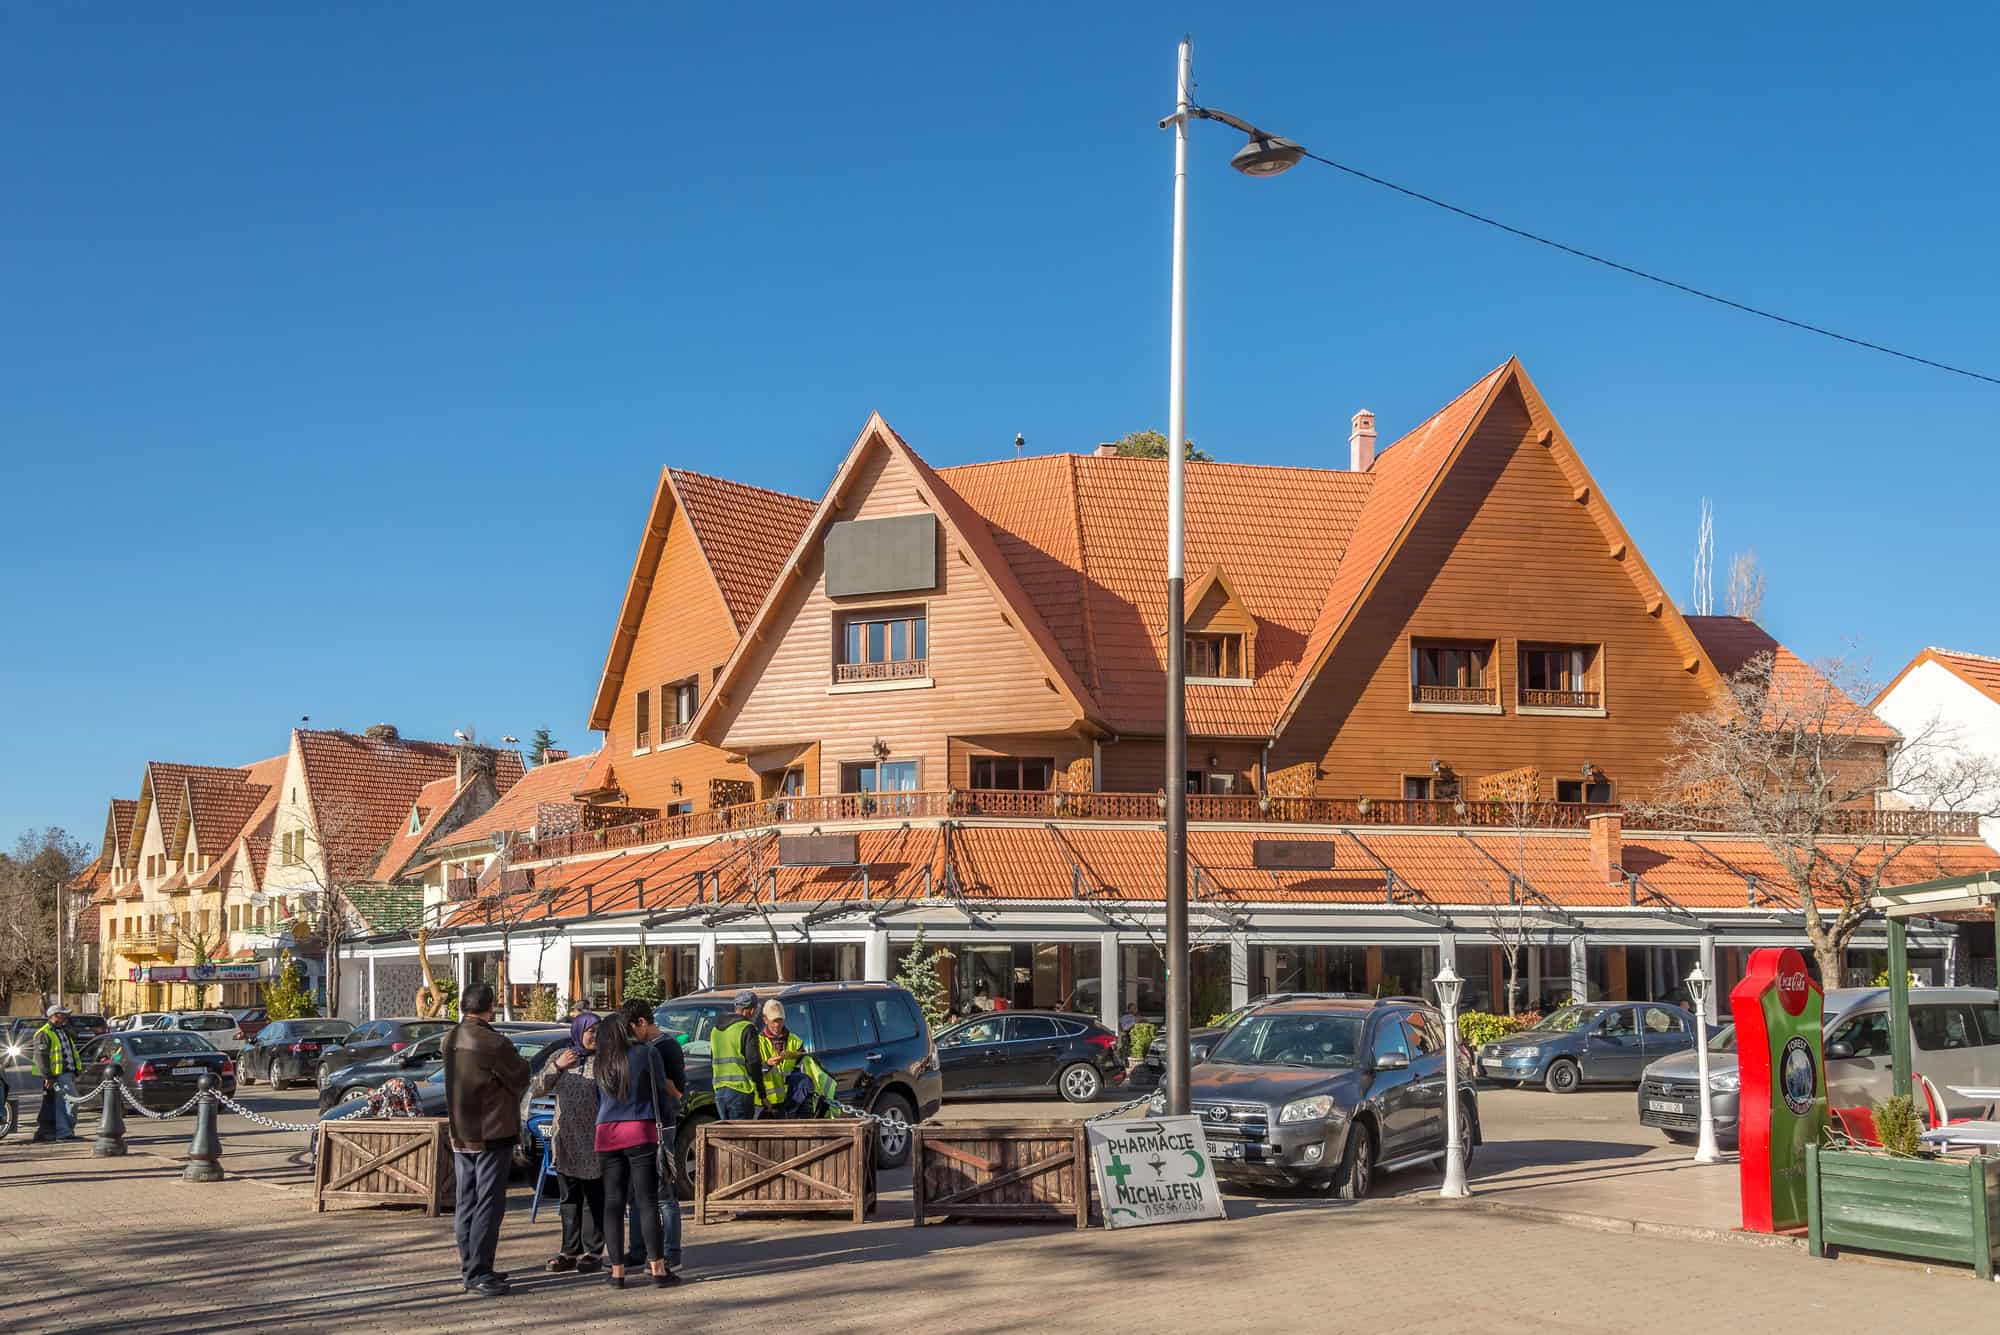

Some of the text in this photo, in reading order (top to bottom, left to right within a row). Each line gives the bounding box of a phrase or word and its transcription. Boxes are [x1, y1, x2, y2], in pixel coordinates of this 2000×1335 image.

[1787, 1039, 1808, 1053] FOREST
[1107, 1133, 1195, 1154] PHARMACIE
[1116, 1182, 1203, 1204] MICHLIFEN
